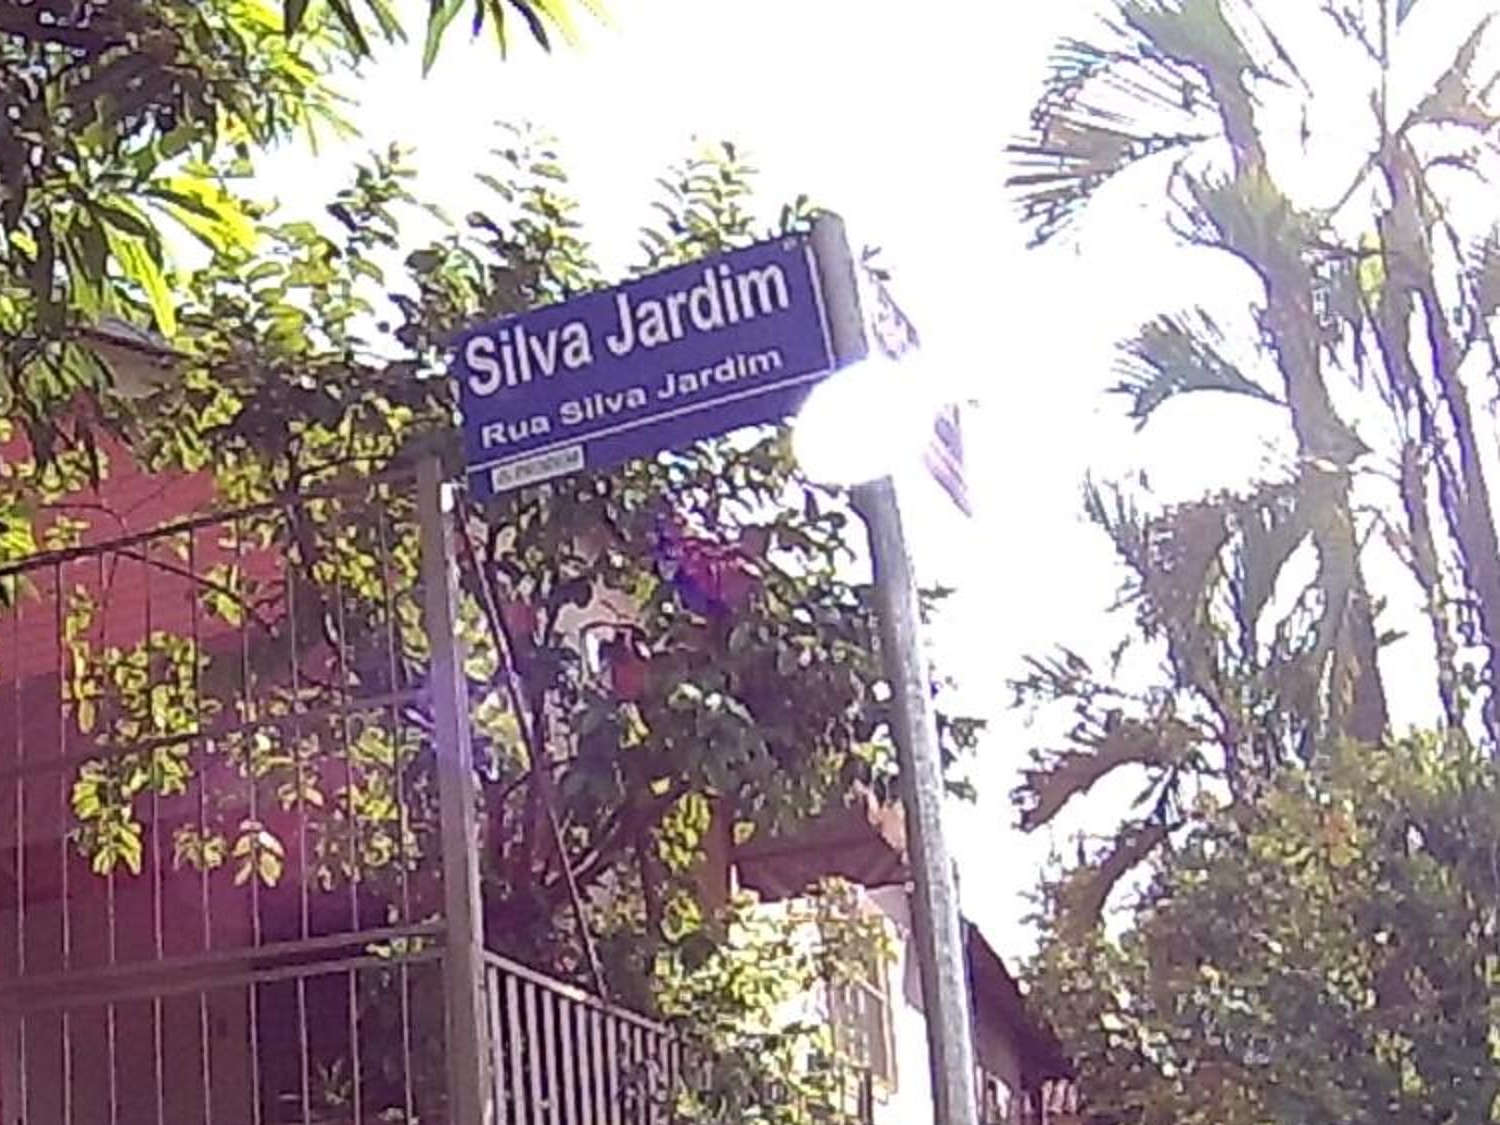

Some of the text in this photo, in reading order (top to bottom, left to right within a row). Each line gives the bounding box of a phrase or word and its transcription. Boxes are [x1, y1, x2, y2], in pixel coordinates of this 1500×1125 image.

[466, 263, 790, 397] Silva Jardim
[481, 350, 784, 449] Rua Silva Jardim
